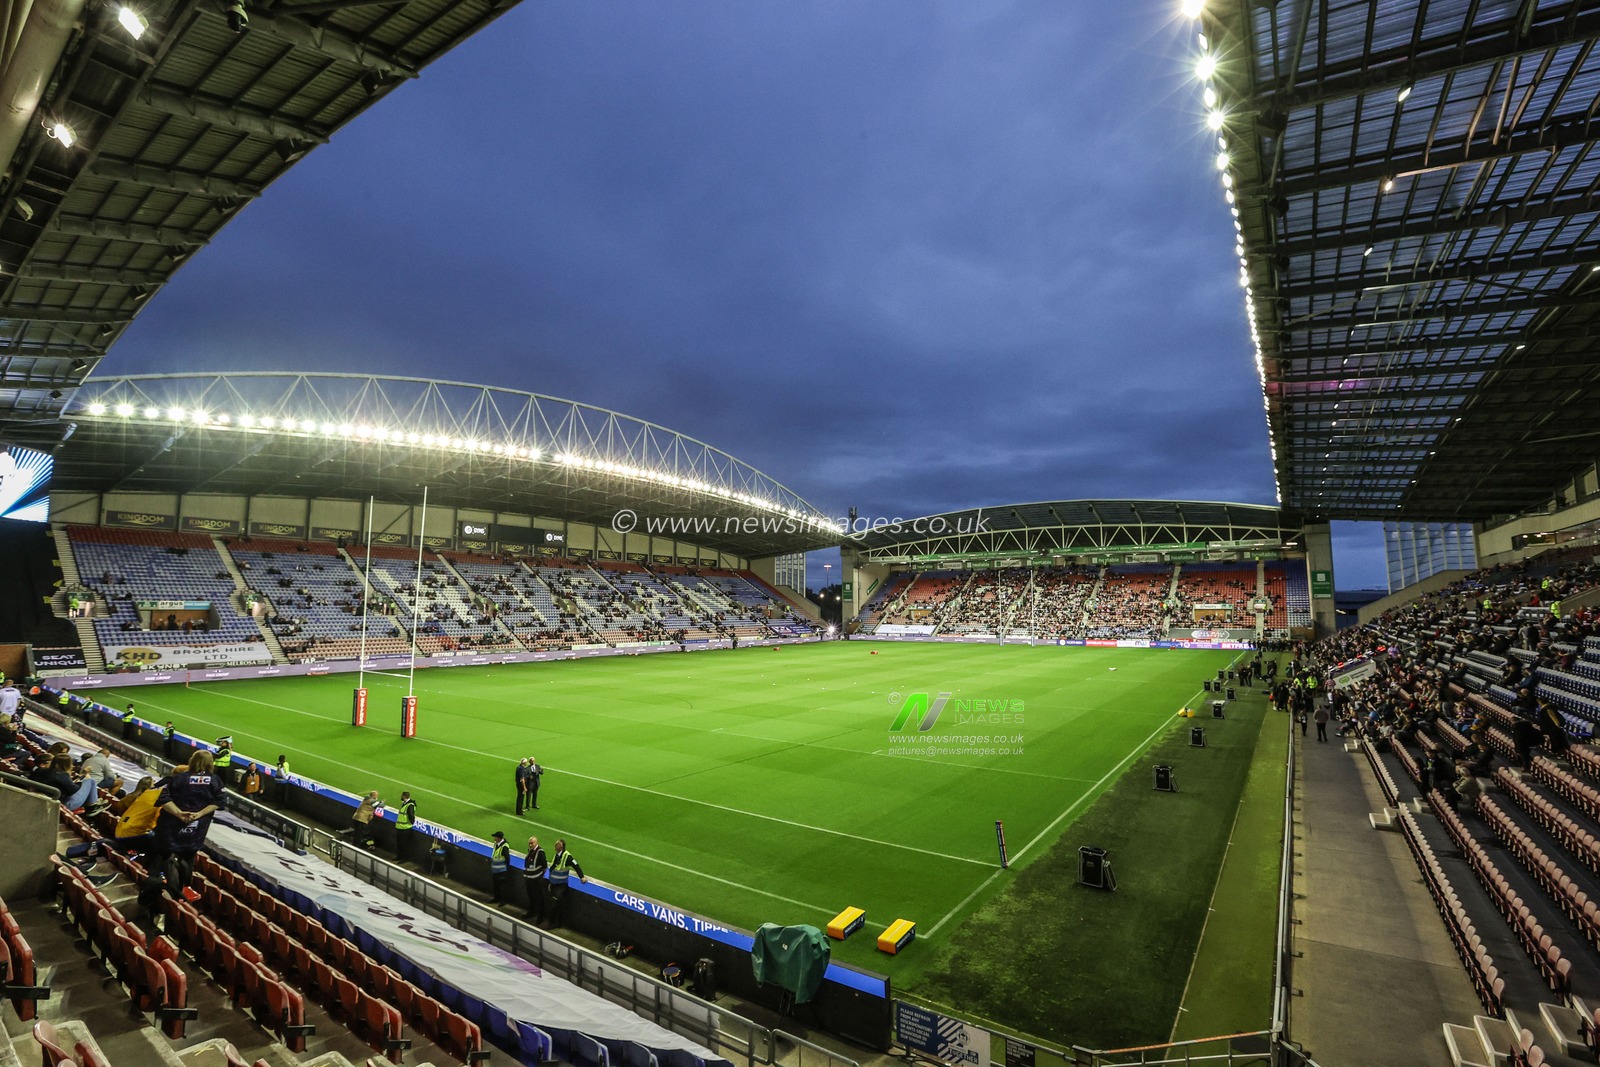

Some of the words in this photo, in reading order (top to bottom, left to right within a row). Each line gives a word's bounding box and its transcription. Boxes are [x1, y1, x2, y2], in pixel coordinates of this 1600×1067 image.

[117, 513, 165, 523] KINGDOM
[188, 519, 231, 528] KINGDOM
[259, 524, 297, 533] KINGDOM
[115, 651, 163, 660] KHD
[34, 659, 86, 667] UNIQUE
[412, 820, 429, 835] ARS,
[614, 891, 648, 915] CARS,
